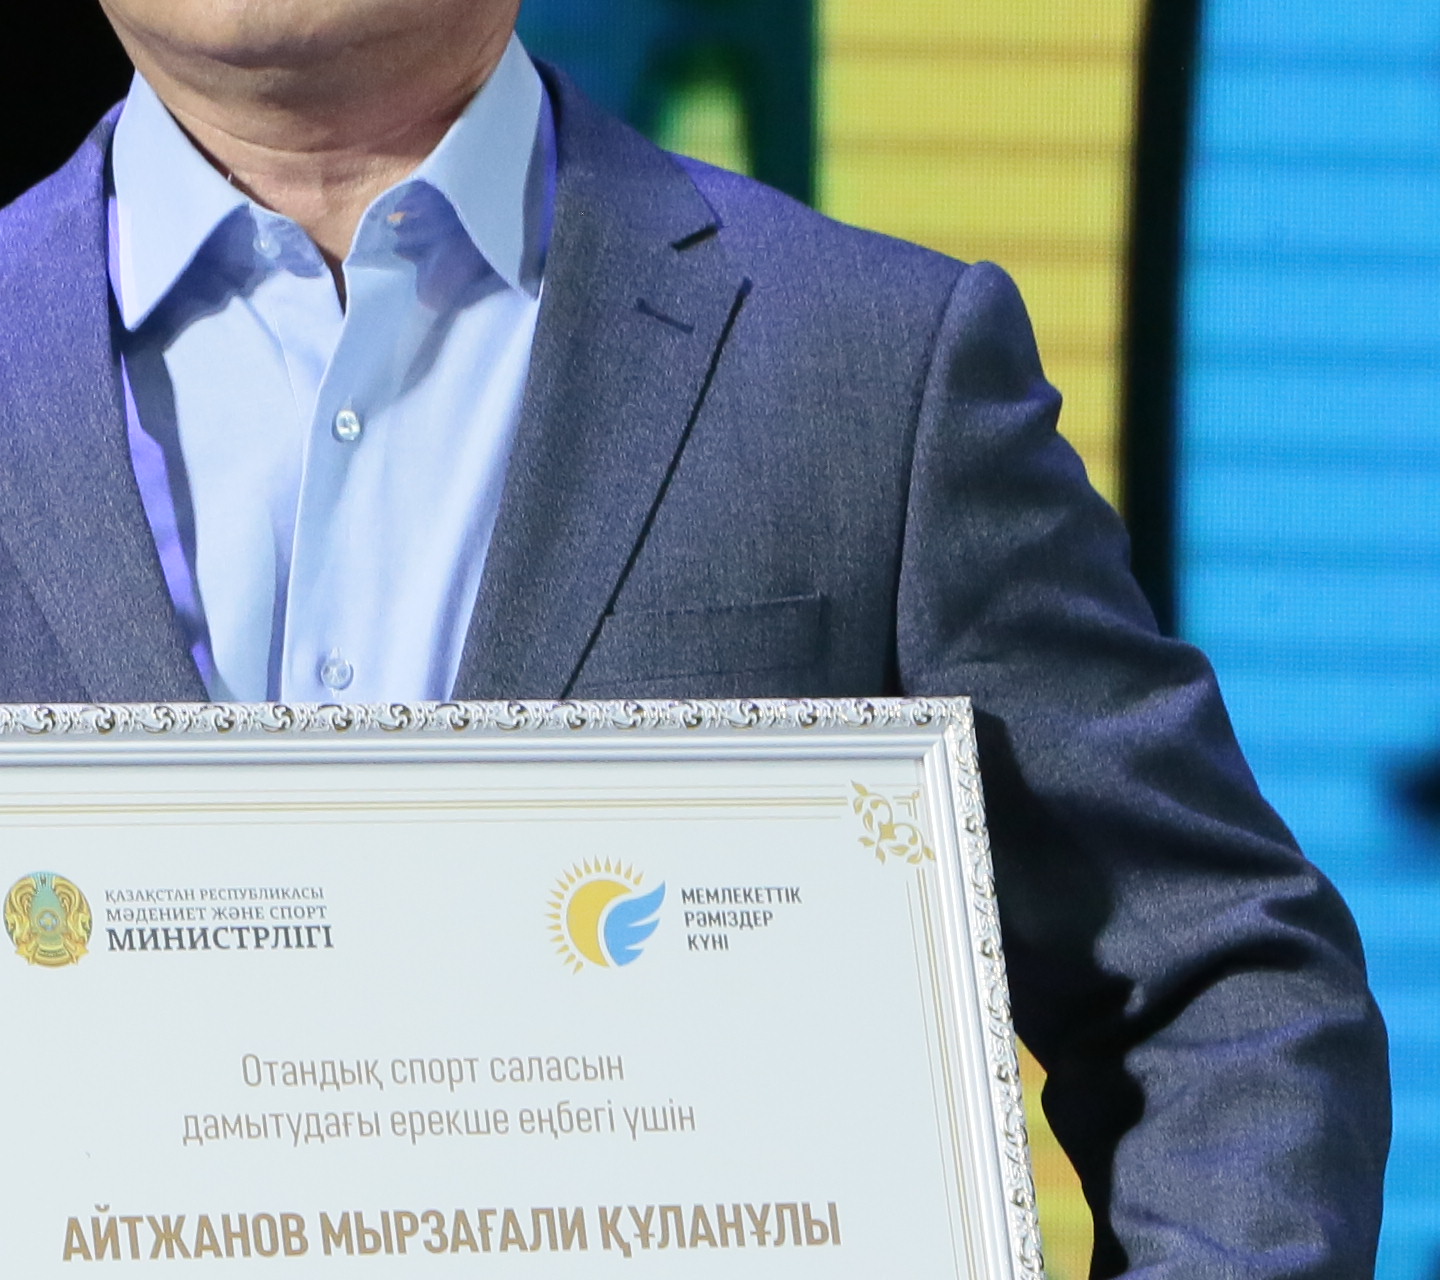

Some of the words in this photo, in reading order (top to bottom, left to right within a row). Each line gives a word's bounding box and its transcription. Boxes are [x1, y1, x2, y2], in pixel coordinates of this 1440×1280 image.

[105, 888, 195, 904] ҚАЗАҚСТАН
[200, 887, 324, 901] РЕСПУБЛИКАСЫ
[681, 886, 802, 905] МЕМЛЕКЕТТІК
[106, 906, 206, 924] МӘДЕНИЕТ
[211, 906, 264, 920] ЖӘНЕ
[270, 905, 327, 920] СПОРТ
[684, 910, 773, 930] РӘМІЗДЕР
[105, 925, 334, 951] МИНИСТРЛІГІ
[687, 933, 729, 951] КҮНІ
[242, 1053, 384, 1091] Отандық
[391, 1057, 479, 1092] спорт
[490, 1055, 624, 1083] саласын
[183, 1111, 380, 1147] дамытудағы
[390, 1109, 509, 1145] ерекше
[519, 1099, 615, 1140] еңбегі
[623, 1098, 695, 1141] үшін
[63, 1204, 309, 1261] АЙТЖАНОВ
[319, 1206, 588, 1256] МЫРЗАҒАЛИ
[598, 1201, 841, 1258] ҚҰЛАНҰЛЫ
